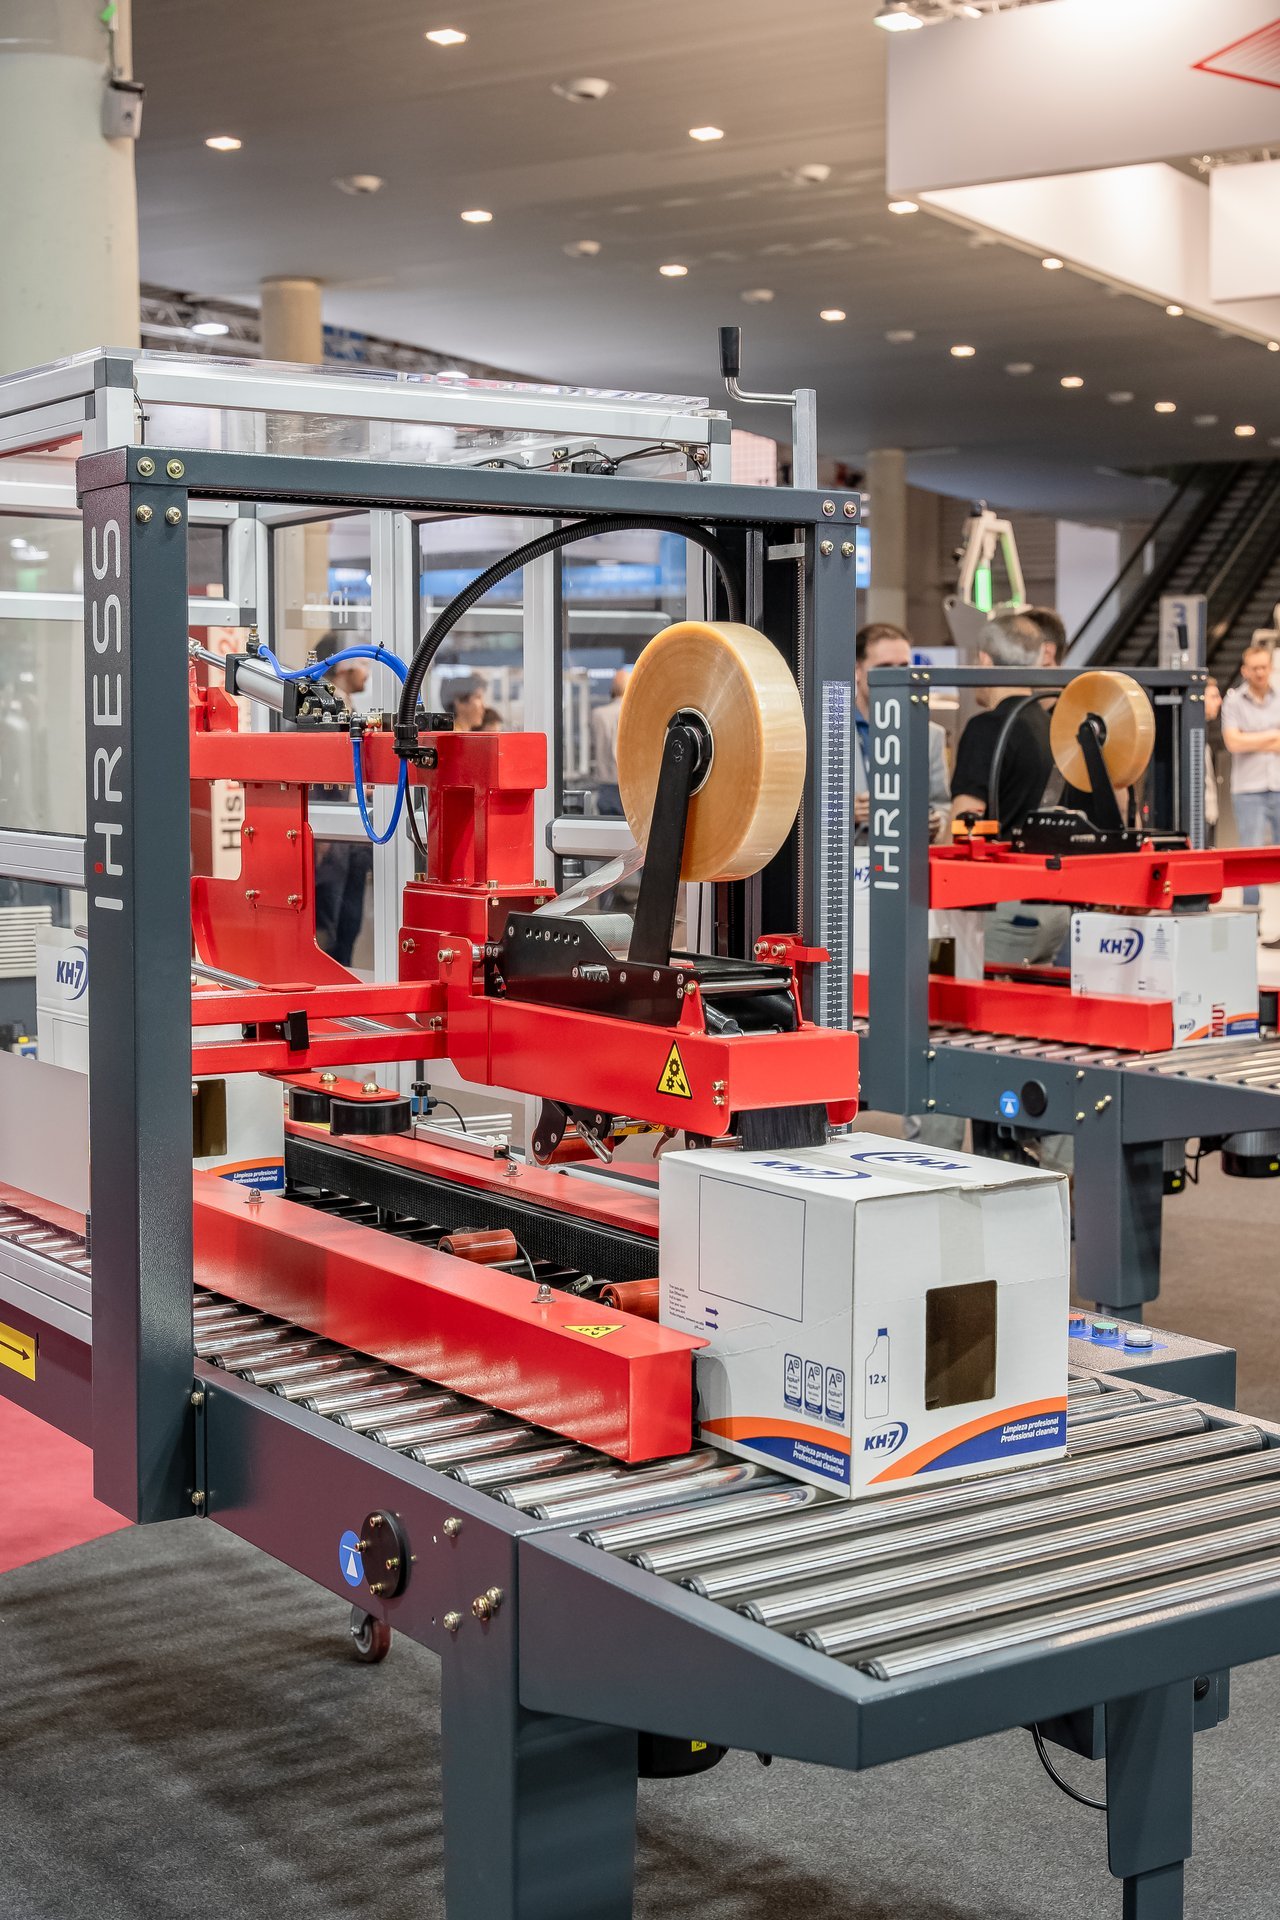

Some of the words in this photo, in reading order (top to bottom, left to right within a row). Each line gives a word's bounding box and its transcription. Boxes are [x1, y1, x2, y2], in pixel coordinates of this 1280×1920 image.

[91, 519, 124, 911] IHRESS
[874, 698, 900, 890] IHRESS
[1000, 1430, 1035, 1443] Professional
[1035, 1426, 1059, 1437] cleaning
[1003, 1422, 1028, 1434] Limpieza
[1028, 1416, 1059, 1431] profesional
[792, 1449, 823, 1467] Professional
[822, 1460, 845, 1477] cleaning
[794, 1440, 816, 1455] Limpieza
[815, 1448, 845, 1466] profesional
